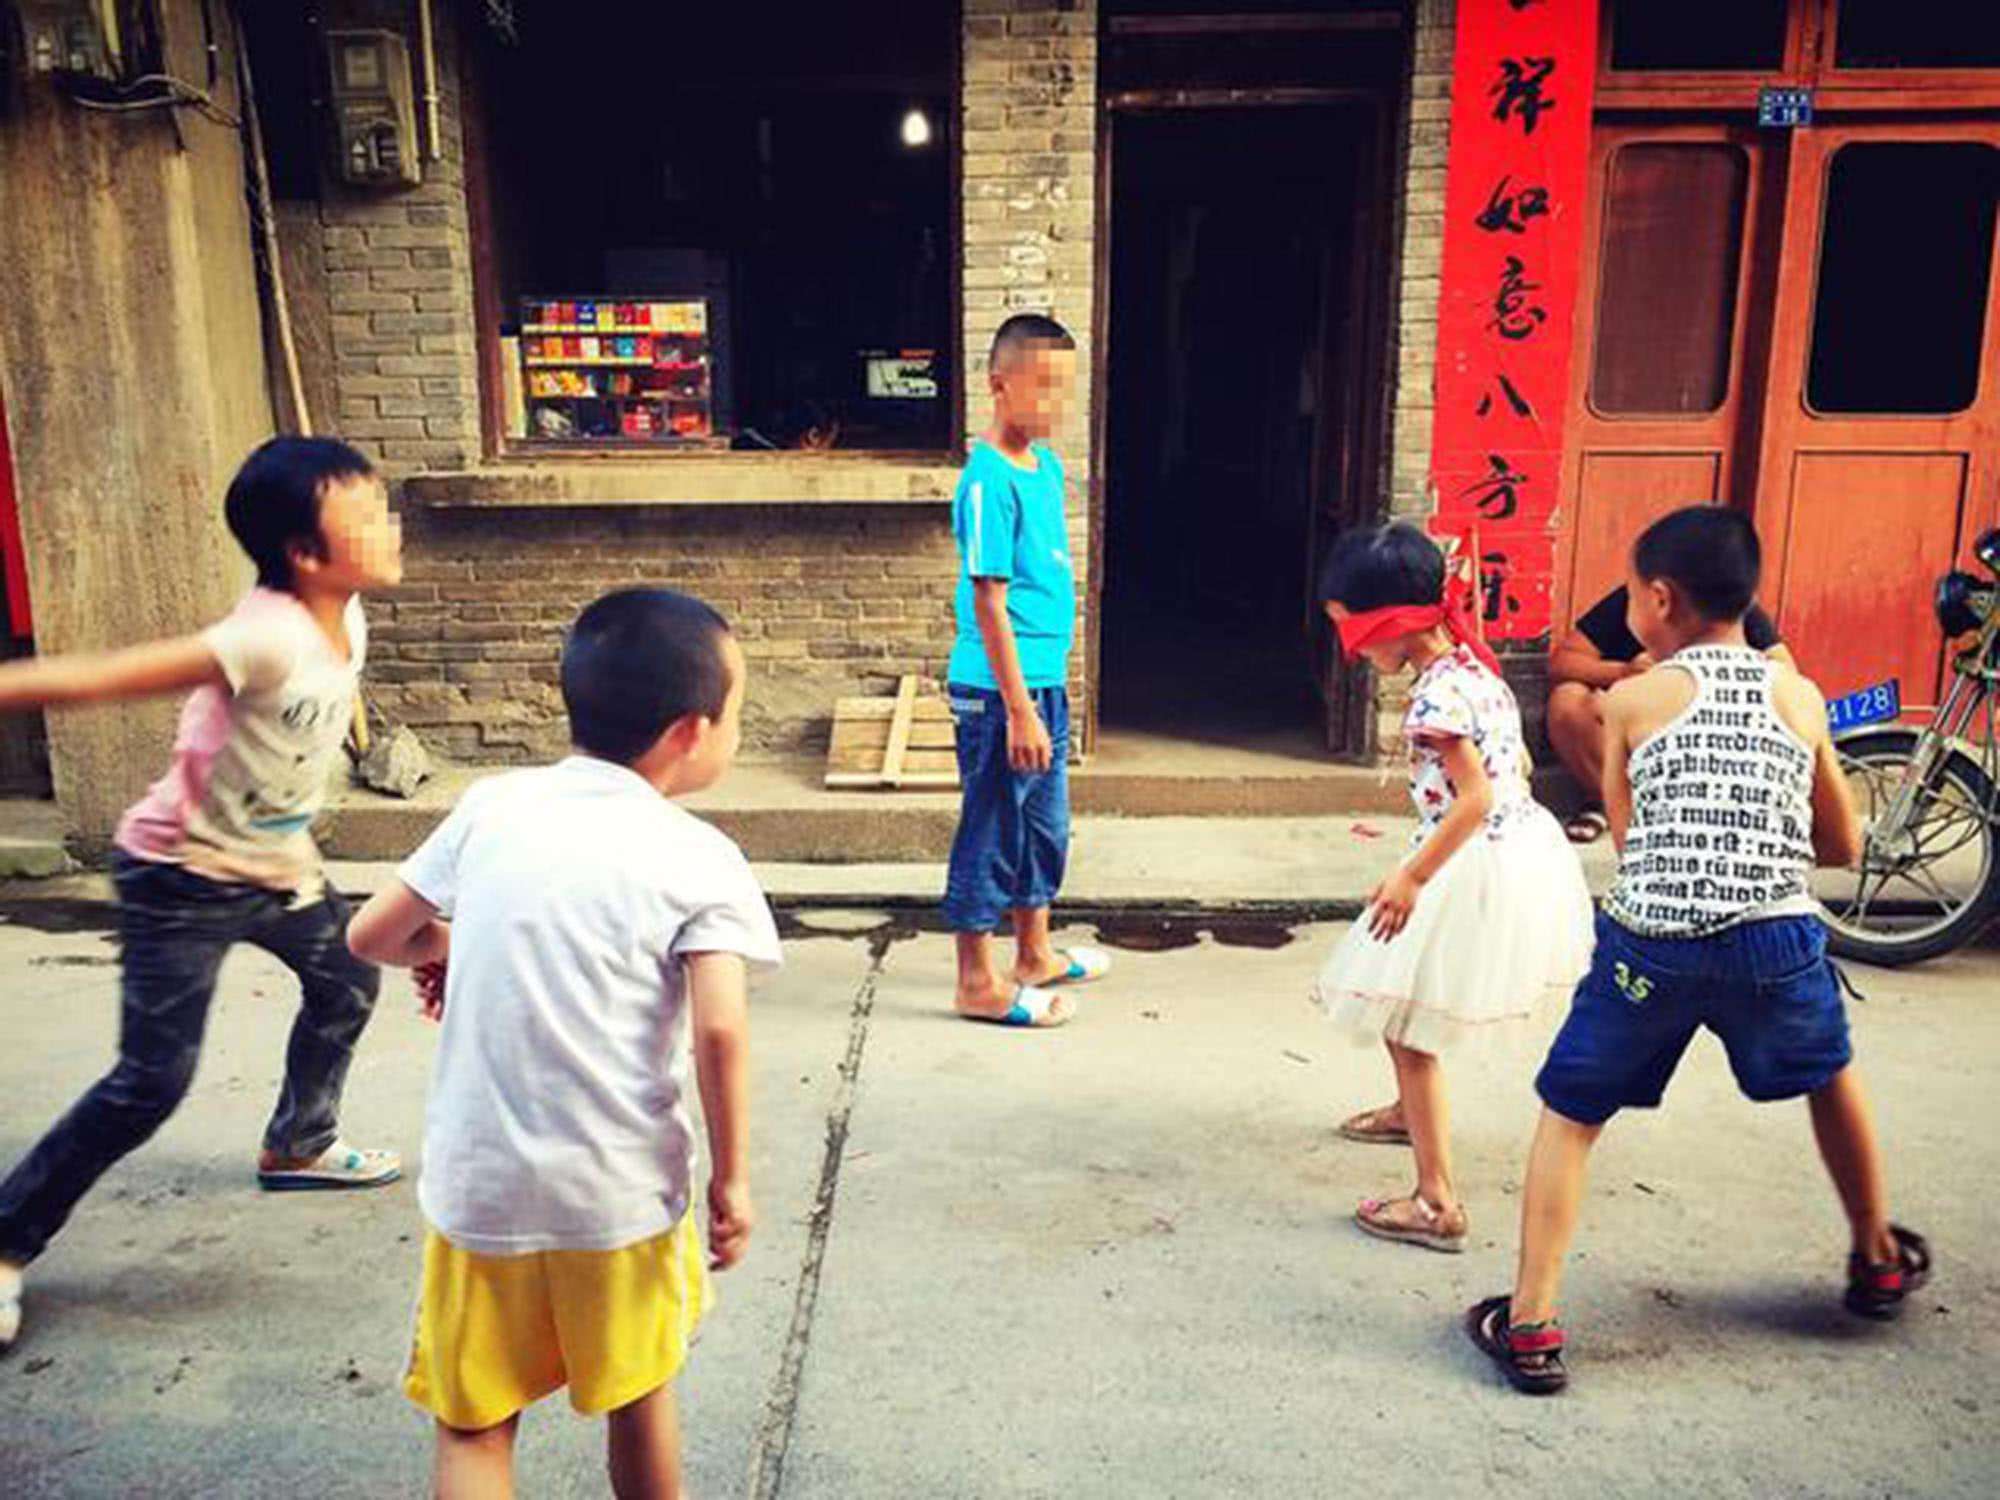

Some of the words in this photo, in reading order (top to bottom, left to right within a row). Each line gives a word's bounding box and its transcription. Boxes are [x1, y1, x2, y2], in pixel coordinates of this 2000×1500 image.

[1460, 0, 1556, 621] 祥如意八方乐
